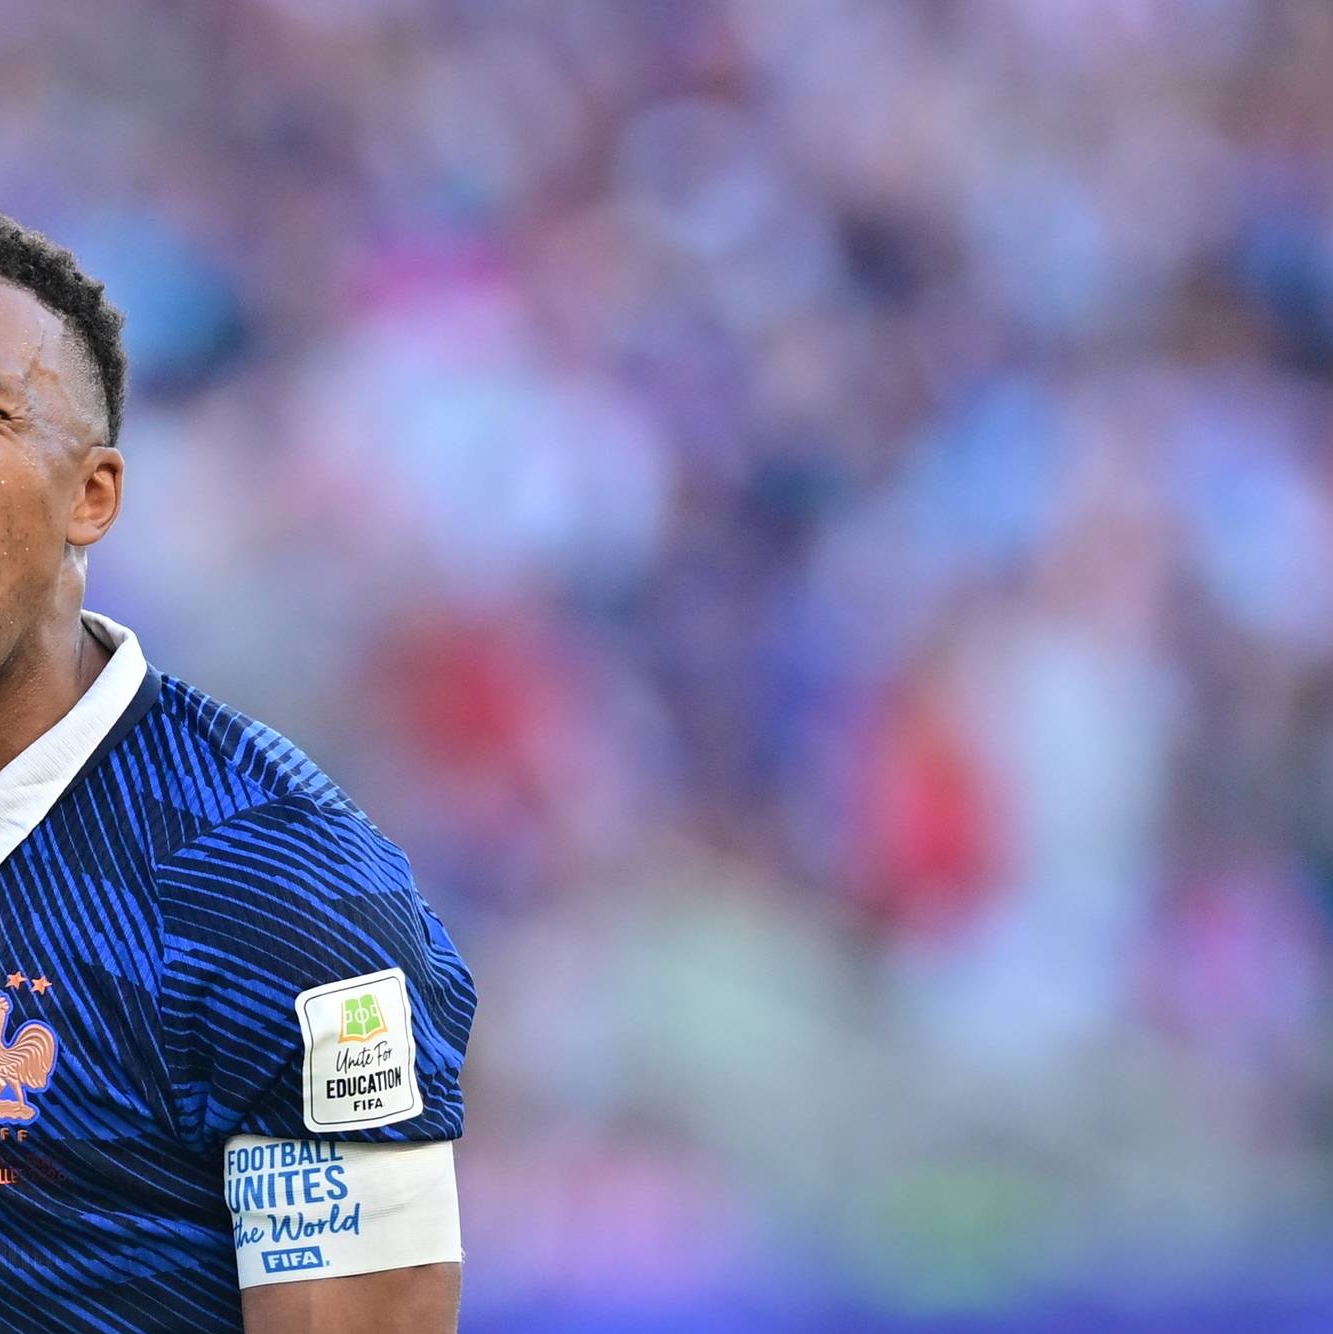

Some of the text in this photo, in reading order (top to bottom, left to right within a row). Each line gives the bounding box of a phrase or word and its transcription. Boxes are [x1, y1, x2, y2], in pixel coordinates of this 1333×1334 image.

[336, 1040, 393, 1075] Unite For
[326, 1065, 402, 1099] EDUCATION
[353, 1097, 383, 1112] FIFA
[228, 1139, 343, 1175] FOOTBALL
[228, 1165, 348, 1213] UNITES
[233, 1202, 361, 1250] the World
[266, 1250, 319, 1270] FIFA
